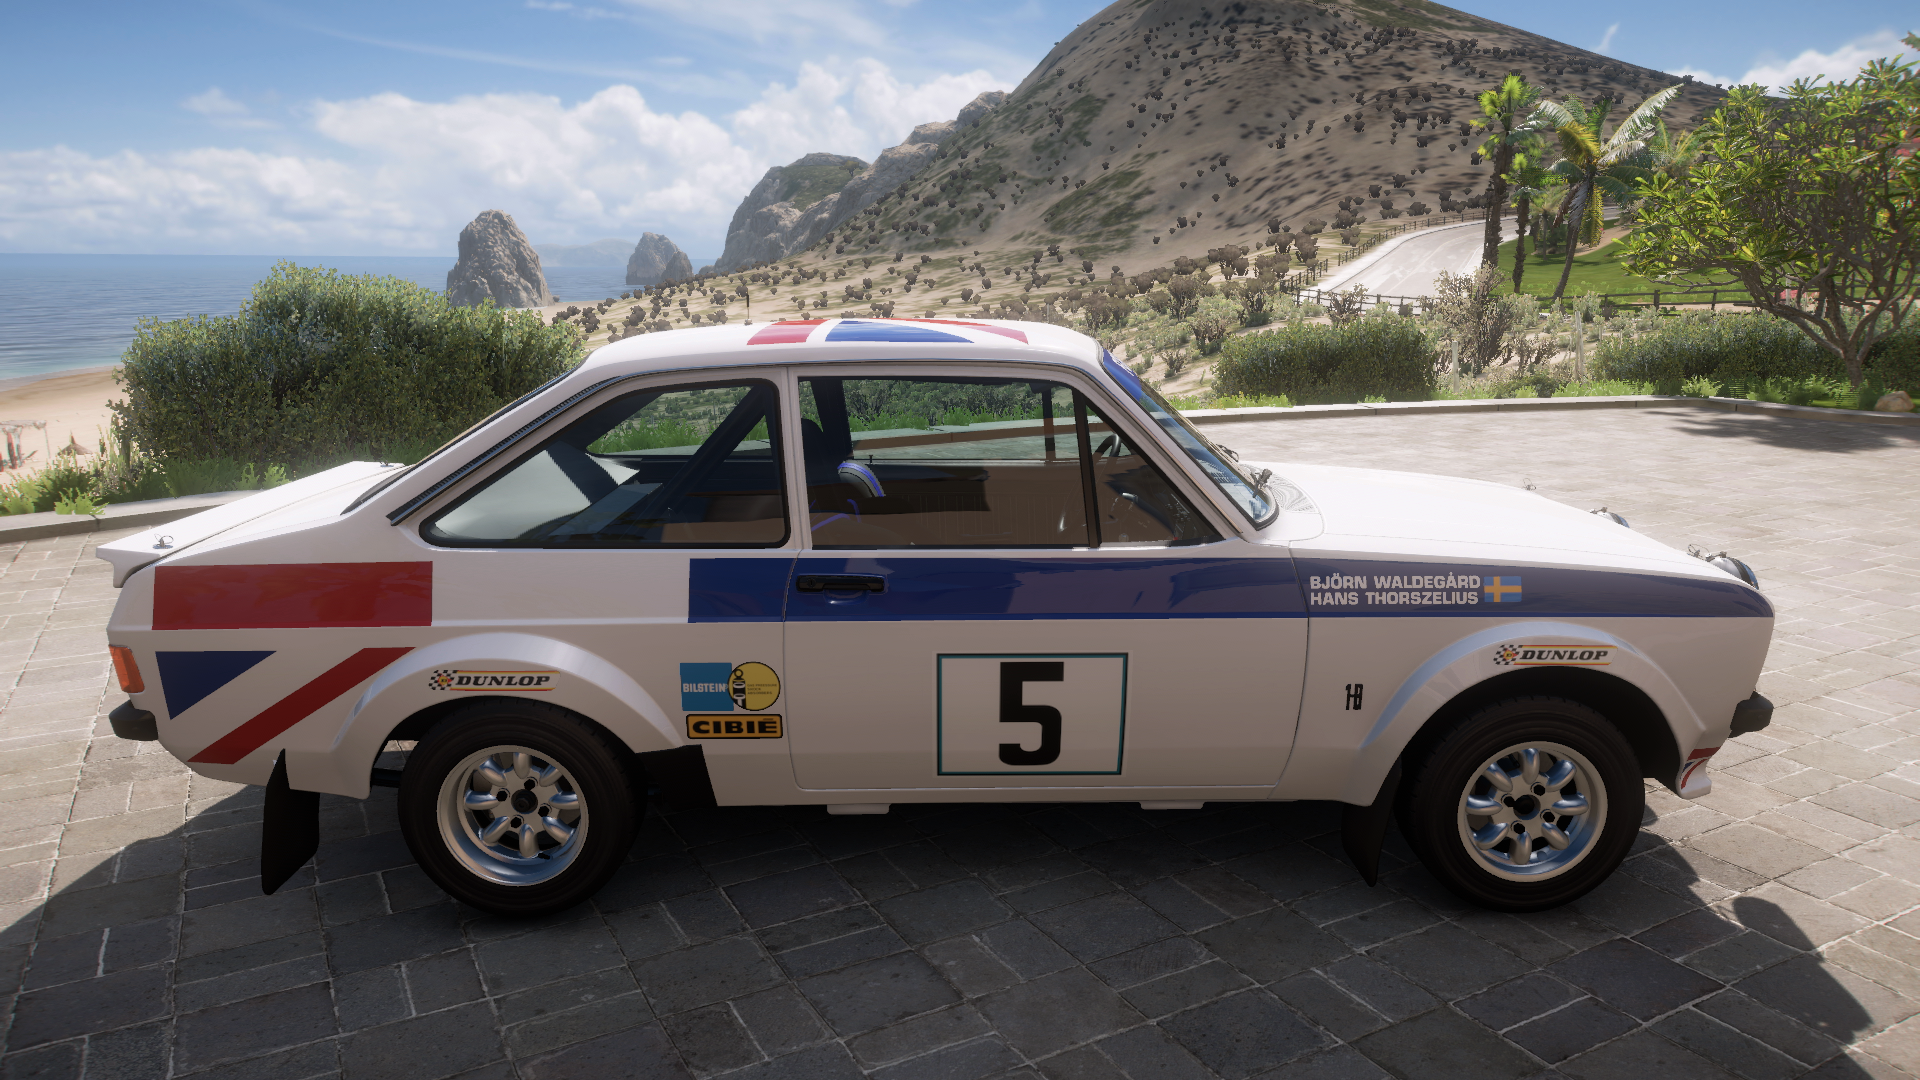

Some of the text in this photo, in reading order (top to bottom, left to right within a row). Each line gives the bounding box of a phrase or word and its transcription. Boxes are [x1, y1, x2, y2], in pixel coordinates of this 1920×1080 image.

[1310, 572, 1480, 589] BJÖRN WALDEGÅRD
[1310, 591, 1479, 605] HANS THORSZELIUS
[1519, 650, 1608, 660] DUNLOP
[455, 676, 550, 686] DUNLOP
[682, 683, 726, 693] BILSTEIN
[999, 661, 1064, 766] 5
